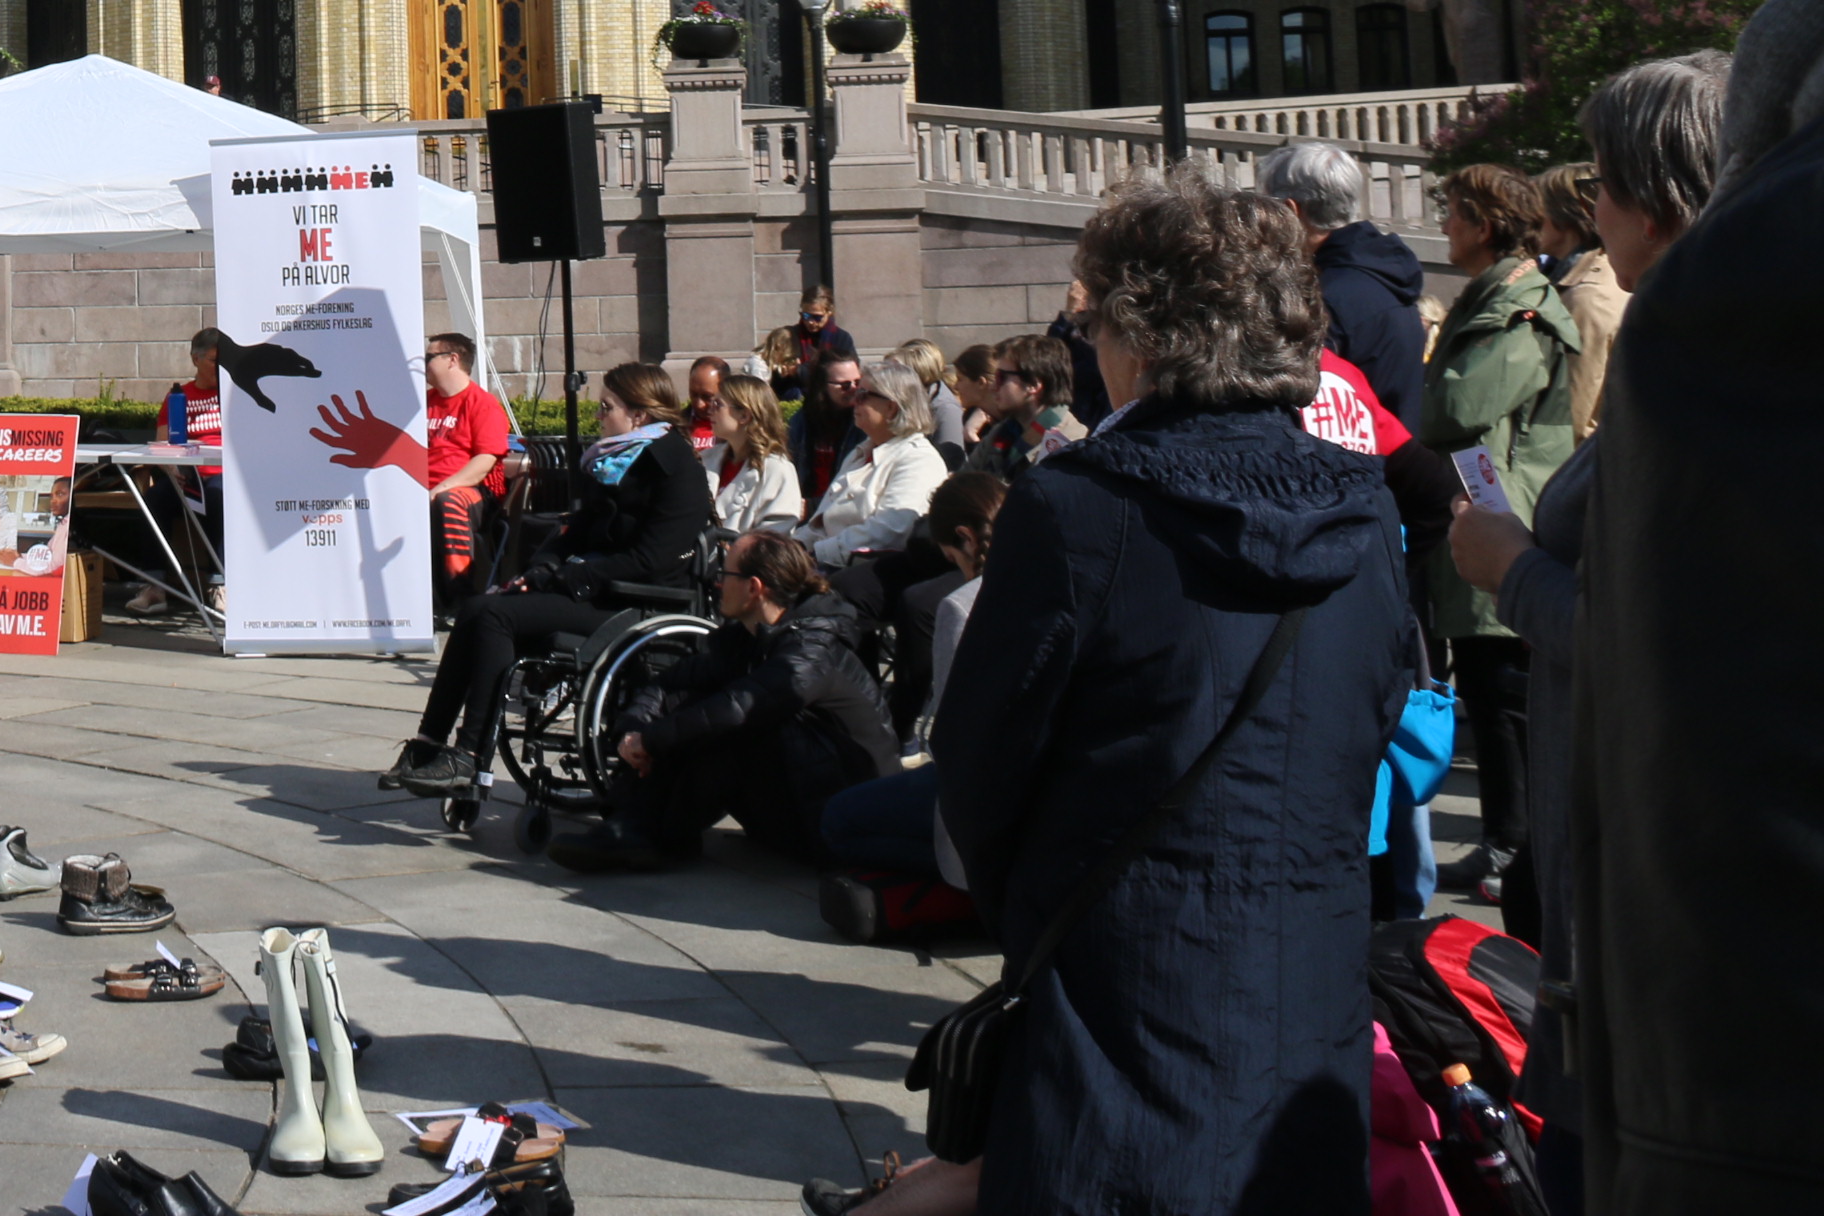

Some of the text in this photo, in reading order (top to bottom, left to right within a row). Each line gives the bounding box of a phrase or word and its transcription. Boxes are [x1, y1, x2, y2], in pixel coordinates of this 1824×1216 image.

[292, 204, 338, 226] VI TAR
[299, 227, 333, 262] ME
[282, 261, 350, 287] PÅ ALVOR
[275, 302, 354, 316] NORGES ME-FORENING
[261, 317, 373, 332] OSLO OG AKERSHUS FYLKESLAG
[1311, 387, 1368, 440] #ME
[275, 498, 370, 512] STØTT ME-FORSKNING MED
[304, 529, 336, 547] 13911
[11, 591, 49, 611] JOBB
[16, 615, 47, 636] M.E.
